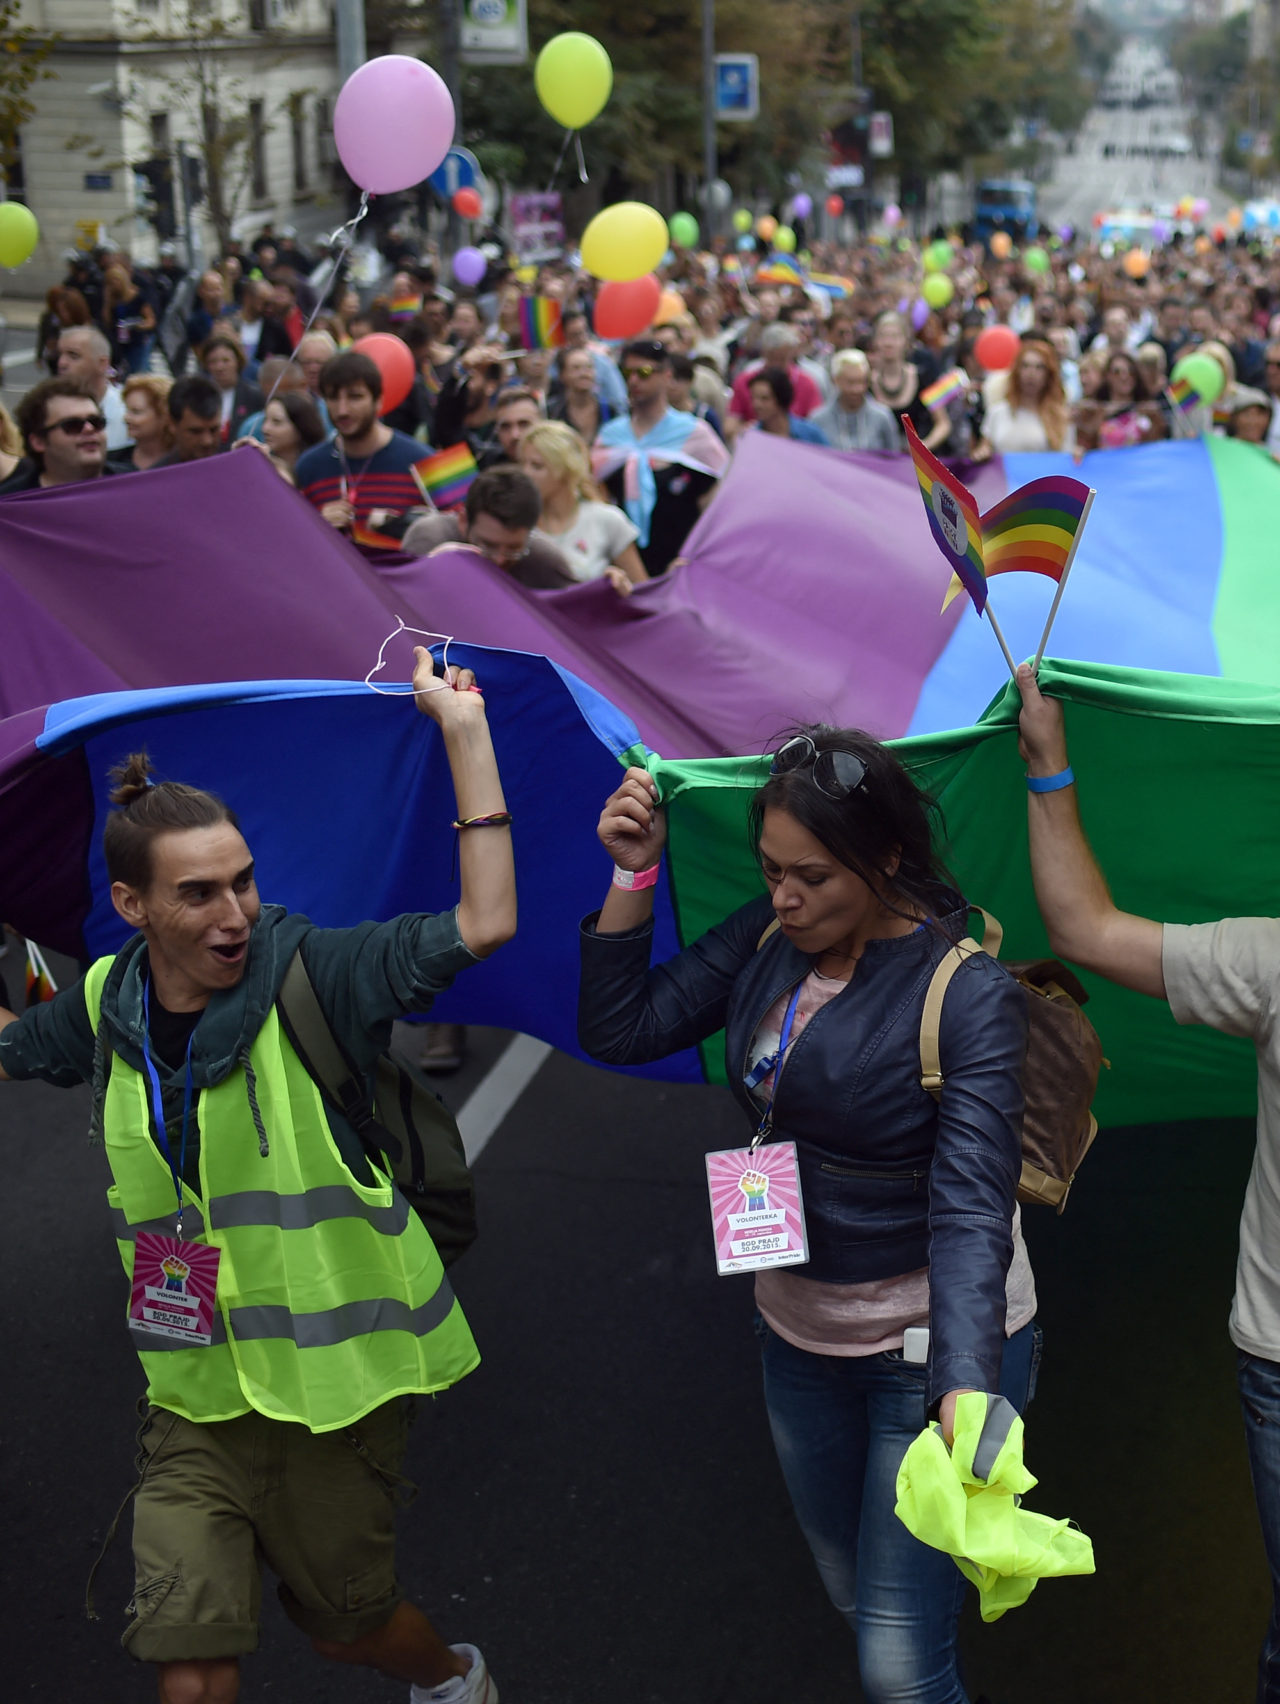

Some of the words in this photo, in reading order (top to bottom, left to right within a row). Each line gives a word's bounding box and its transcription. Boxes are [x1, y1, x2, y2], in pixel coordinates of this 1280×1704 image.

[736, 1213, 778, 1224] VOLONTERKA
[758, 1237, 780, 1245] PRAJD
[156, 1291, 188, 1302] VOLONTER
